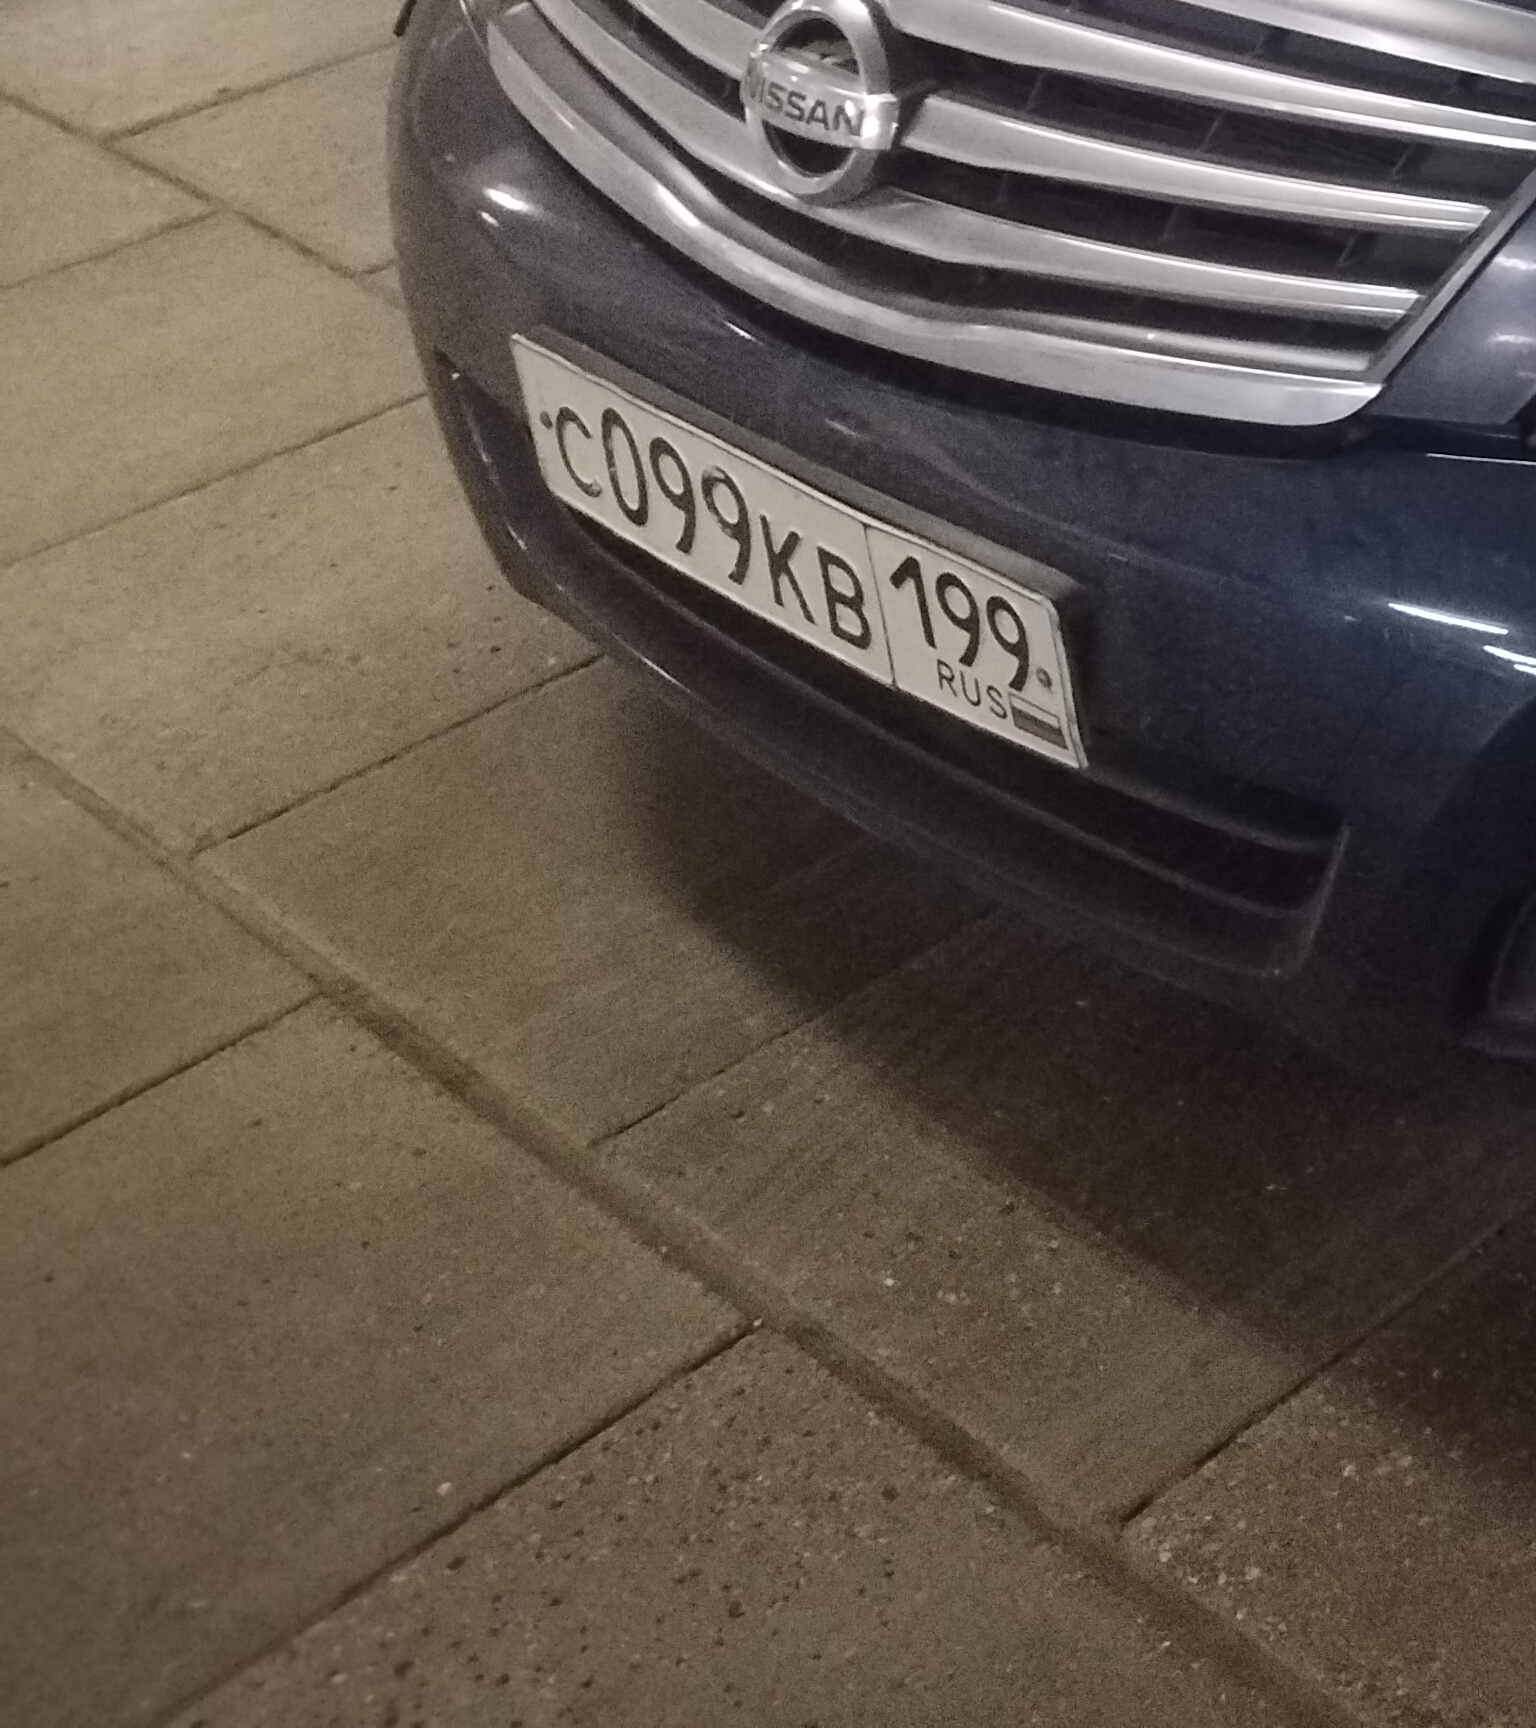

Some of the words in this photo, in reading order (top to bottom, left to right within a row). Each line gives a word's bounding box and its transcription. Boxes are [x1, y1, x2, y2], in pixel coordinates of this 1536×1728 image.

[747, 69, 865, 137] NISSAN
[889, 556, 1030, 693] 199
[937, 659, 1008, 720] RUS
